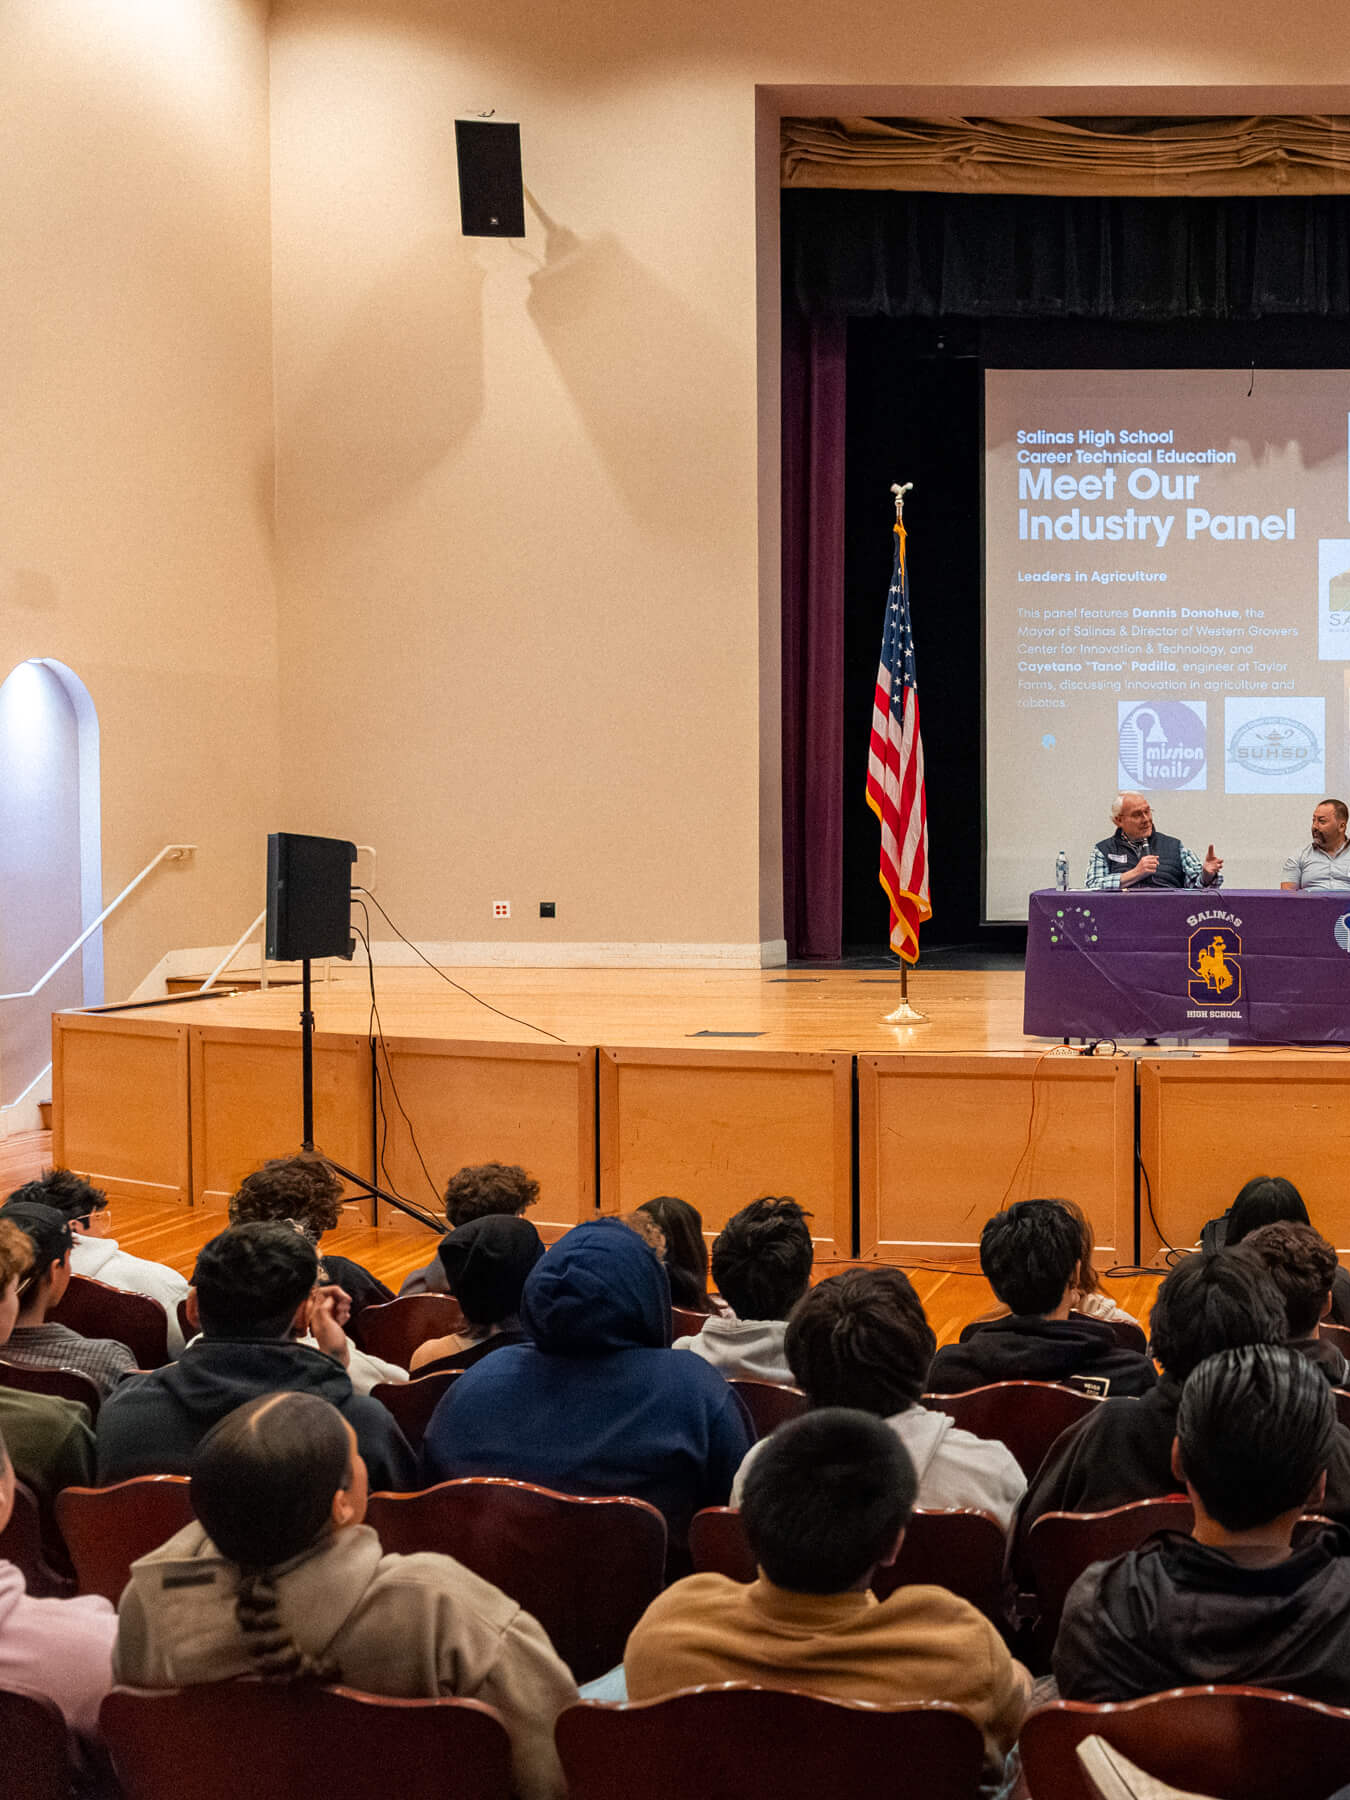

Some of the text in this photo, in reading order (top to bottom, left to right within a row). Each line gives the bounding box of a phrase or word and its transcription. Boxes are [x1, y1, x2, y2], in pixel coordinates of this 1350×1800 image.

[1017, 430, 1174, 448] Salinas High School
[1017, 450, 1237, 464] Career Technical Education
[1018, 467, 1200, 500] Meet Our
[1018, 508, 1296, 548] Industry Panel
[1017, 571, 1168, 585] Leaders in Agriculture
[1017, 607, 1041, 618] This
[1043, 607, 1077, 621] panel
[1080, 607, 1129, 618] features
[1245, 607, 1265, 618] the
[1017, 660, 1082, 675] Cayetano
[1145, 742, 1205, 760] mission
[1145, 761, 1192, 778] trails
[1186, 910, 1243, 928] SALINAS
[1186, 1010, 1243, 1019] HIGH SCHOOL
